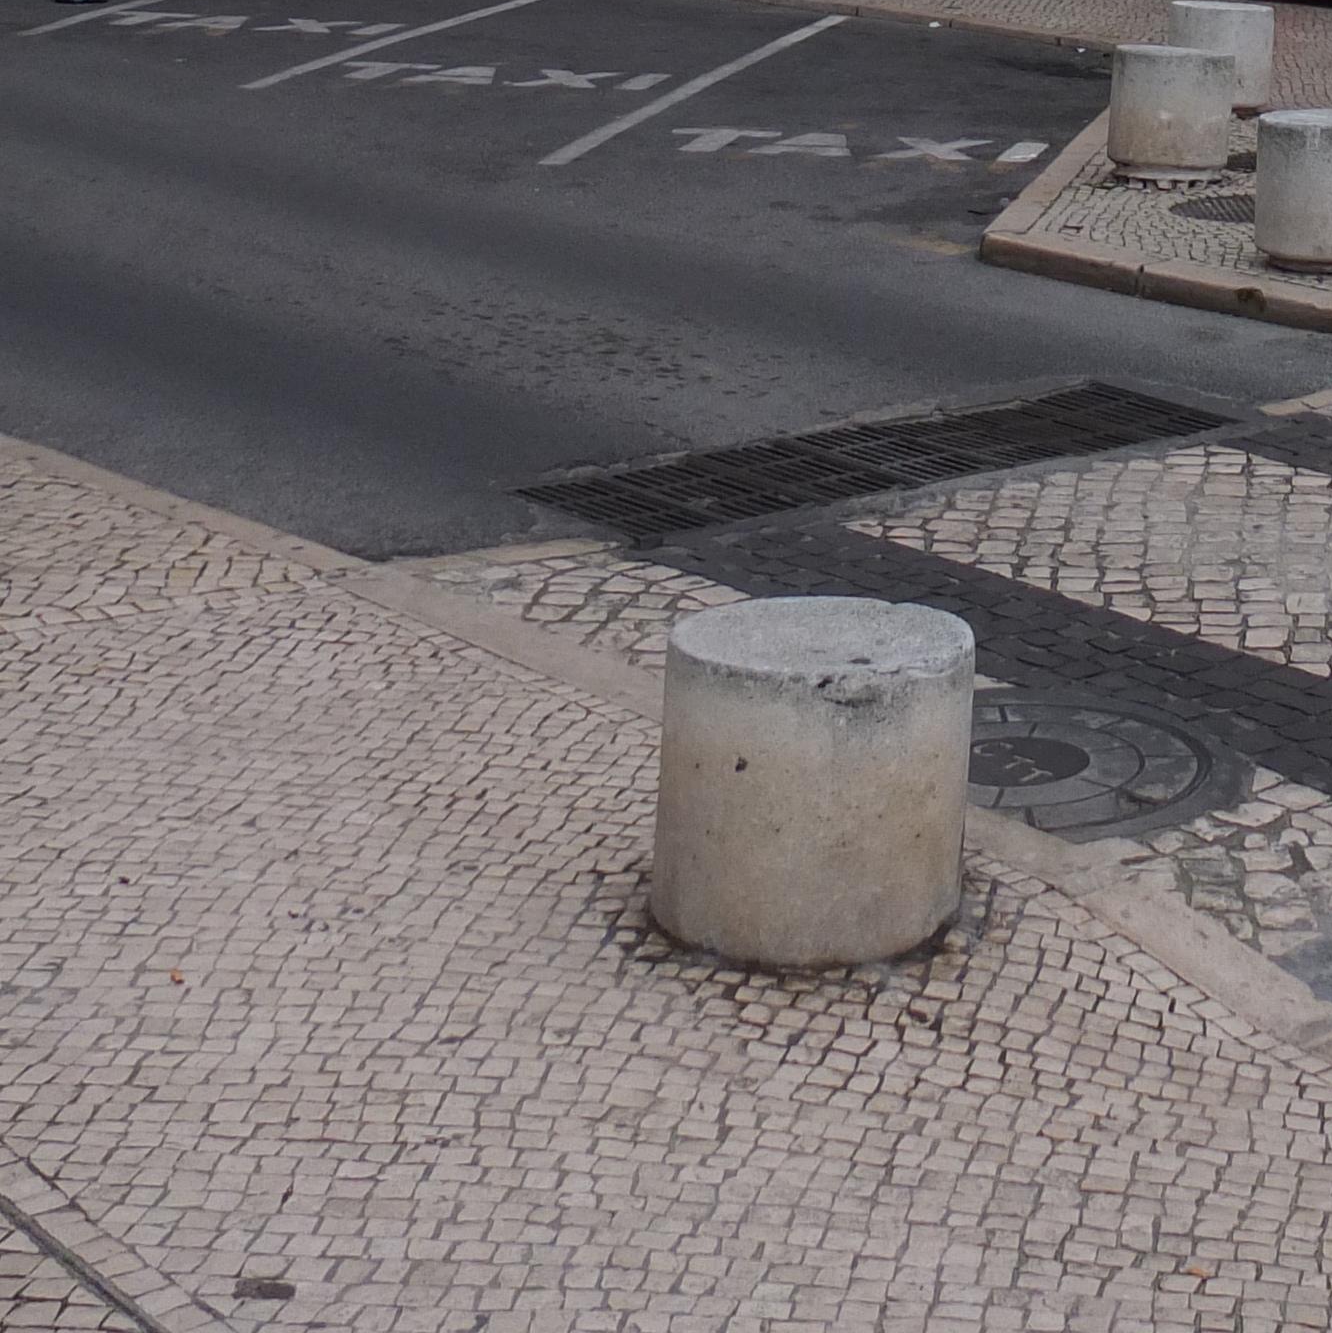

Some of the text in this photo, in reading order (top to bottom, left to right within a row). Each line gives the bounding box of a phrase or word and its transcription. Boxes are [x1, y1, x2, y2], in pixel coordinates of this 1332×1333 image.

[110, 10, 404, 35] TAXI
[343, 61, 672, 91] TAXI
[671, 127, 1050, 163] TAXI
